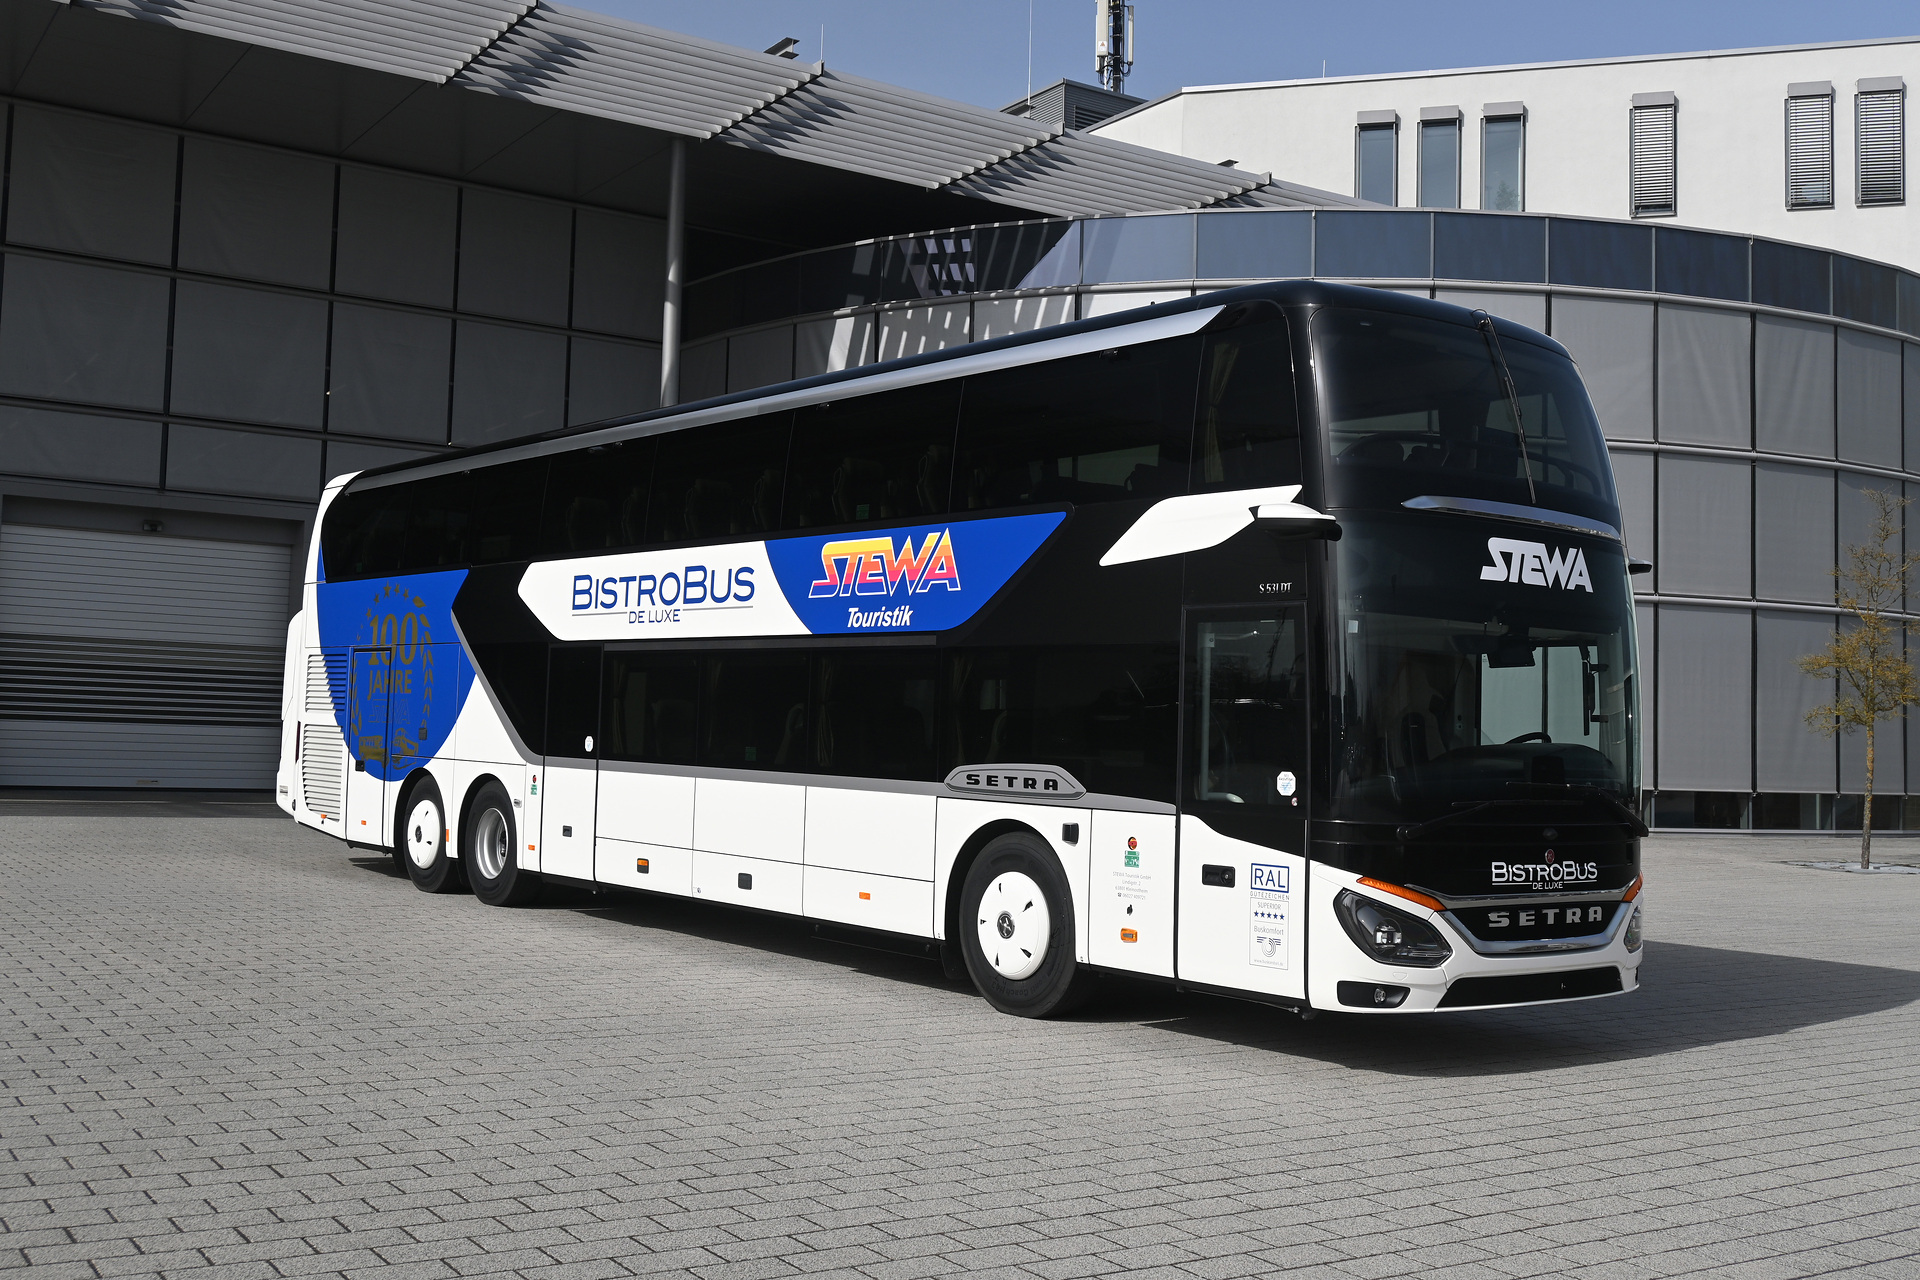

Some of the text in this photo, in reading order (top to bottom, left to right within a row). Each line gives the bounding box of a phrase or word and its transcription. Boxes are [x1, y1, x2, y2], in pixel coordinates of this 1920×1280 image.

[808, 527, 961, 598] STEWA
[1480, 537, 1594, 593] STEWA
[628, 609, 681, 624] DE LUXE
[847, 605, 914, 628] Touristik
[368, 612, 418, 665] 100
[367, 669, 413, 700] JAHRE
[966, 774, 1059, 791] SETRA
[1254, 868, 1286, 888] RAL
[1544, 881, 1563, 889] LUXE
[1488, 906, 1602, 927] SETRA
[1253, 925, 1284, 935] Buskomfort
